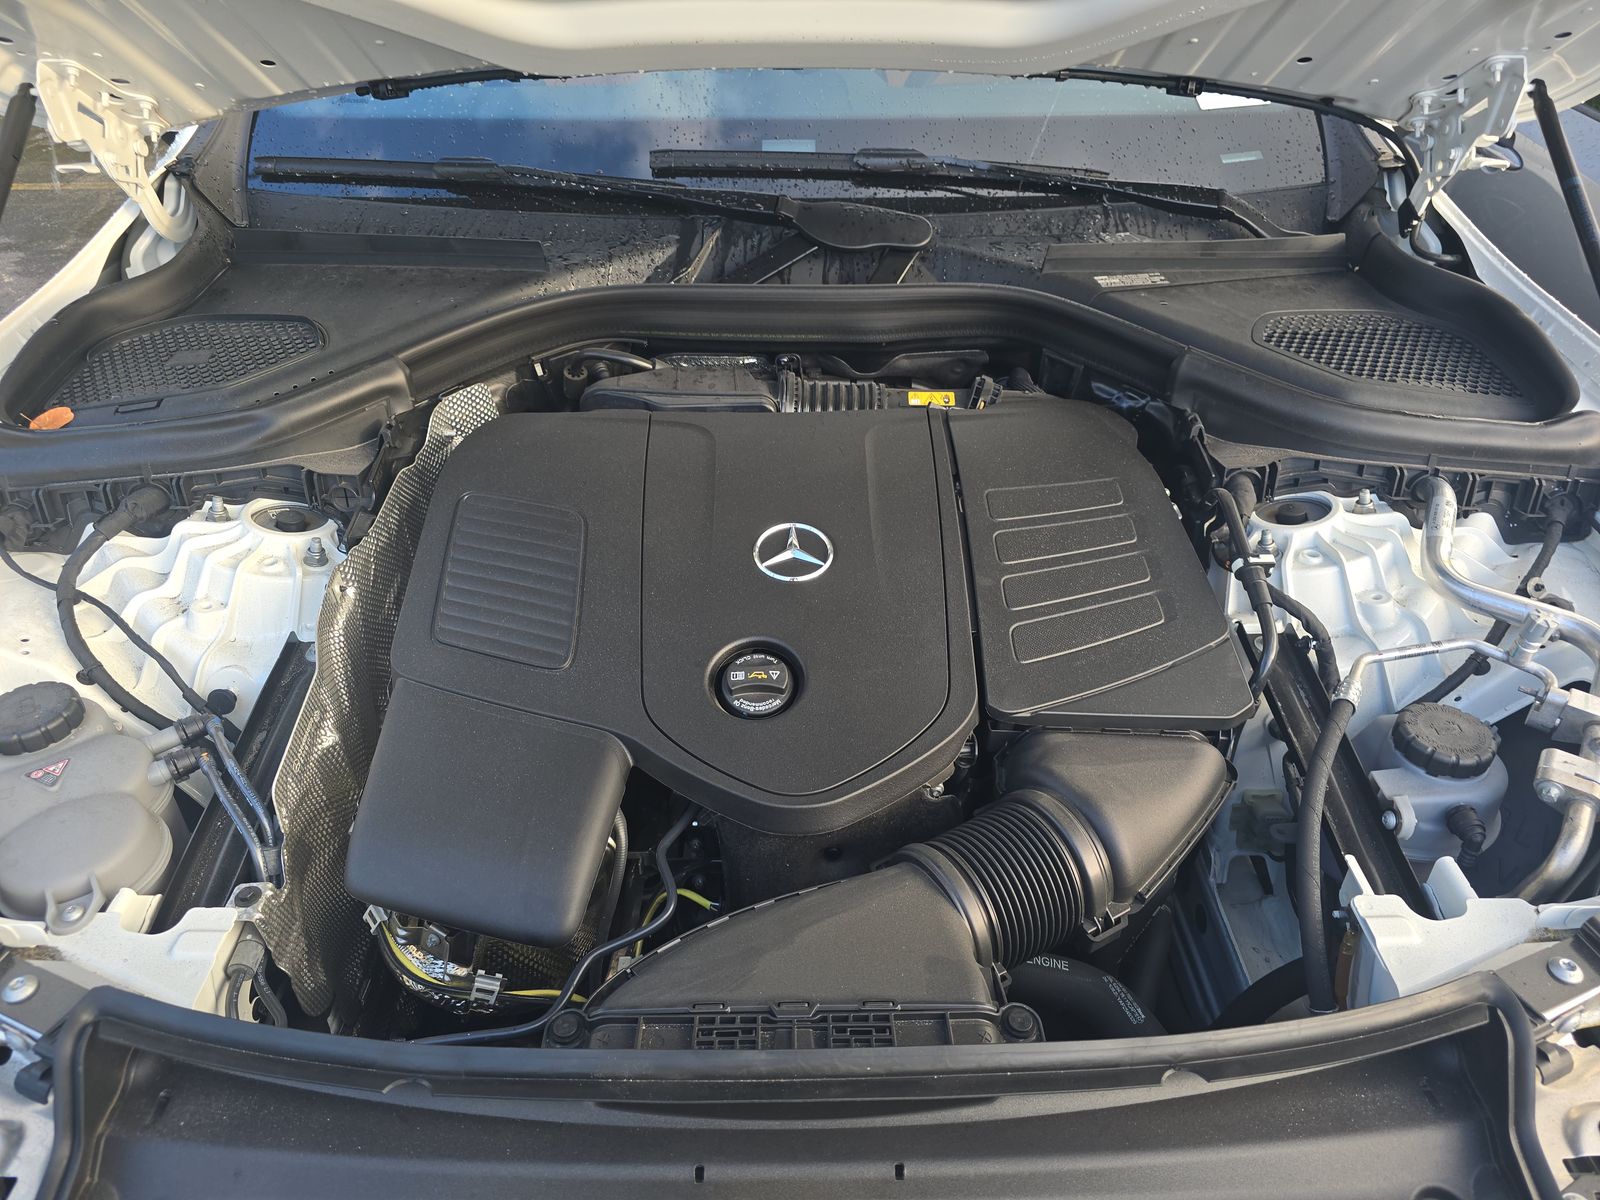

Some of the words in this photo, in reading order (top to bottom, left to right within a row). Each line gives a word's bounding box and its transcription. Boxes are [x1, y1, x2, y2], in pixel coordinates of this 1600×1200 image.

[735, 655, 751, 664] CLICK
[767, 656, 778, 664] Turn
[740, 698, 775, 706] recommended
[740, 699, 782, 711] Mercedes-Benz
